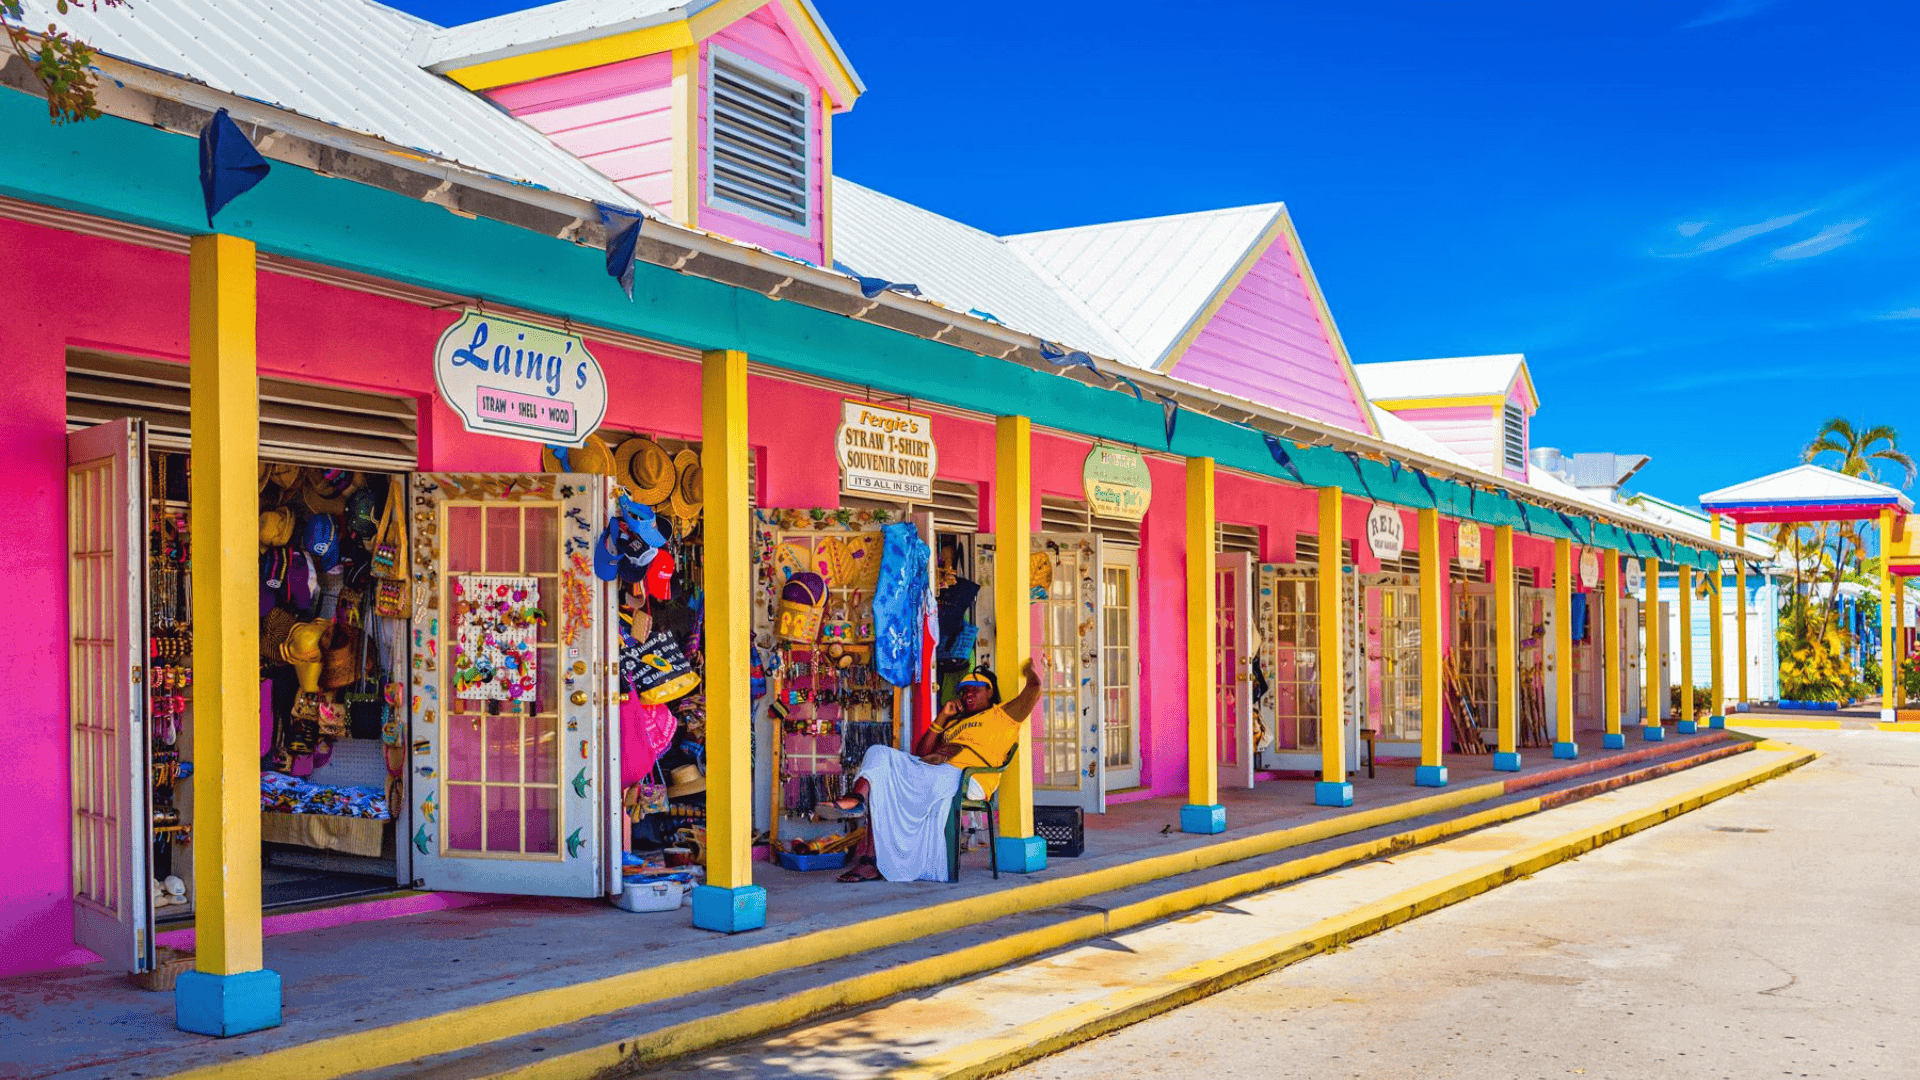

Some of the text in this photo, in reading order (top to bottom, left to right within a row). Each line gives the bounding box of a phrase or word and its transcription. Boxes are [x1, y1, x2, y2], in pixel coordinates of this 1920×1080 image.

[452, 322, 587, 396] Laing's
[482, 396, 569, 423] STRAW SHELL WOOD
[860, 410, 919, 434] Fergie's
[845, 428, 885, 450] STRAW
[847, 450, 929, 478] SOUVENIR STORE
[854, 477, 924, 493] IT'S ALL IN SIDE
